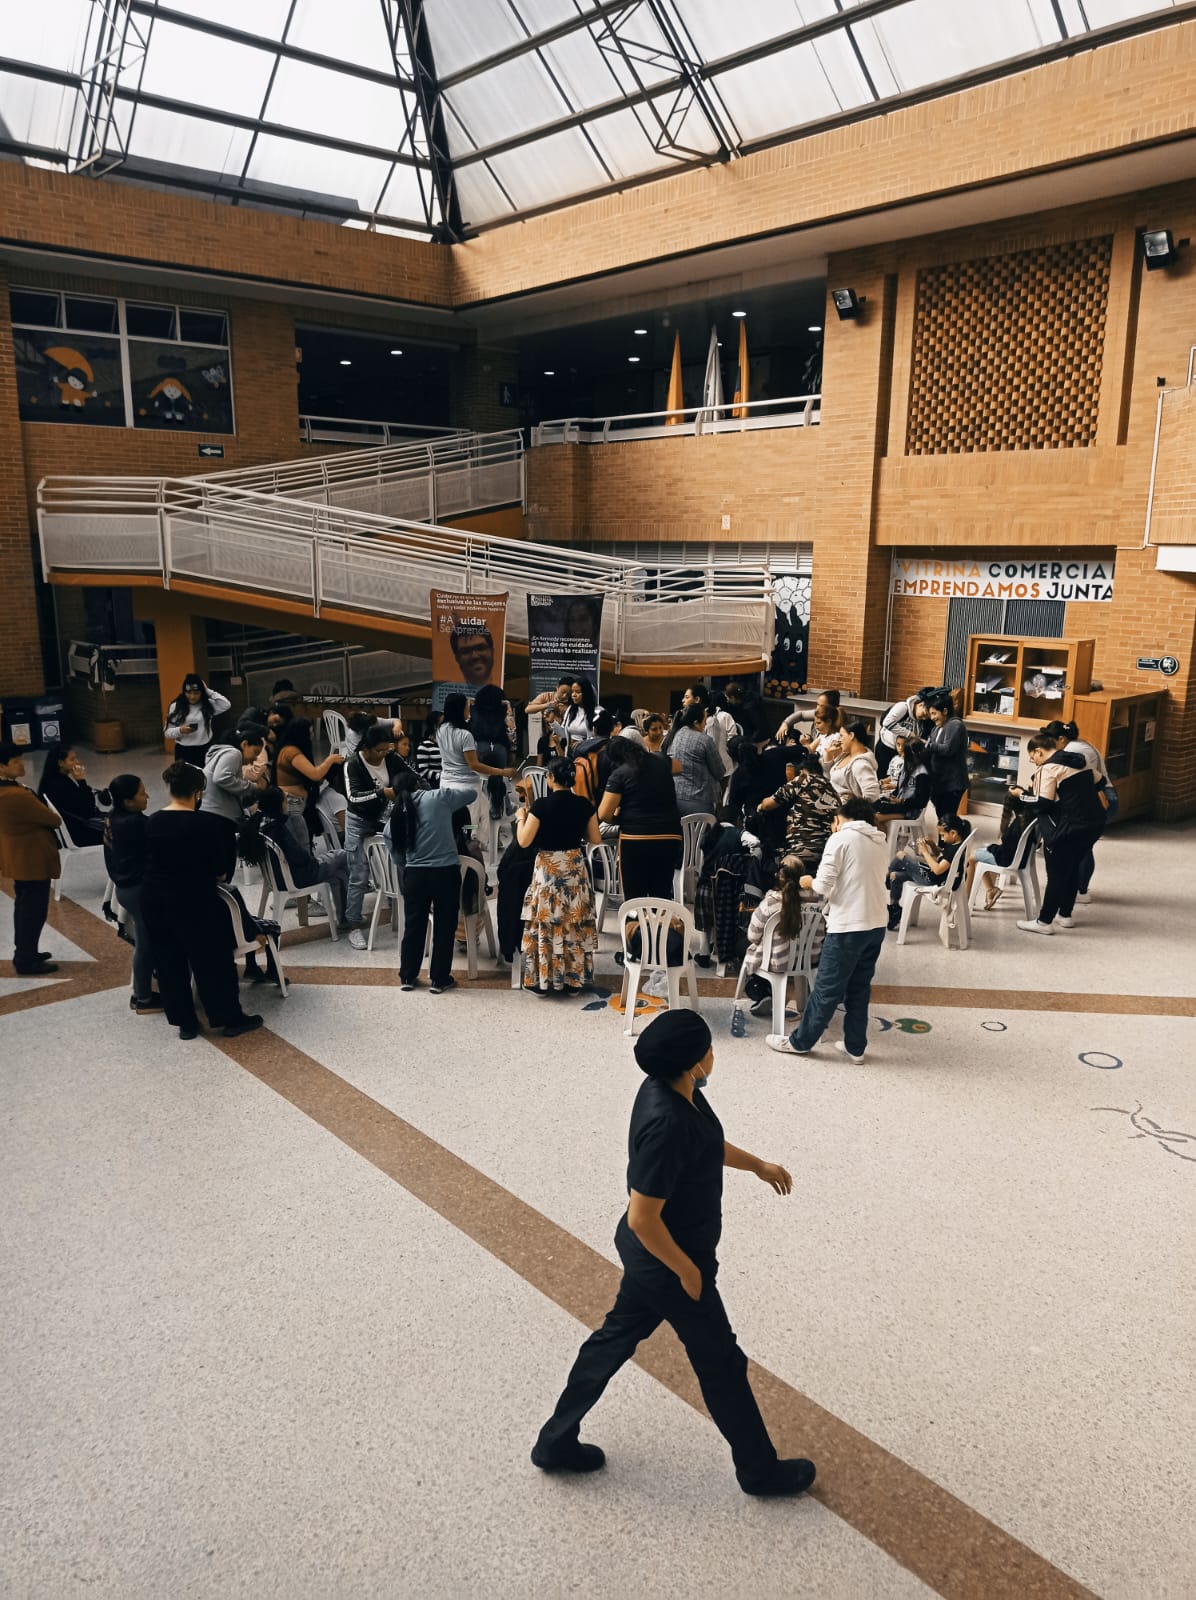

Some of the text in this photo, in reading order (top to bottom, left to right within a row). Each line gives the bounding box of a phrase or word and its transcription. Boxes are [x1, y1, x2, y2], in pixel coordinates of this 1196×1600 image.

[902, 560, 981, 578] VITRINA
[894, 579, 1041, 599] EMPRENDAMOS
[460, 617, 486, 626] uidar
